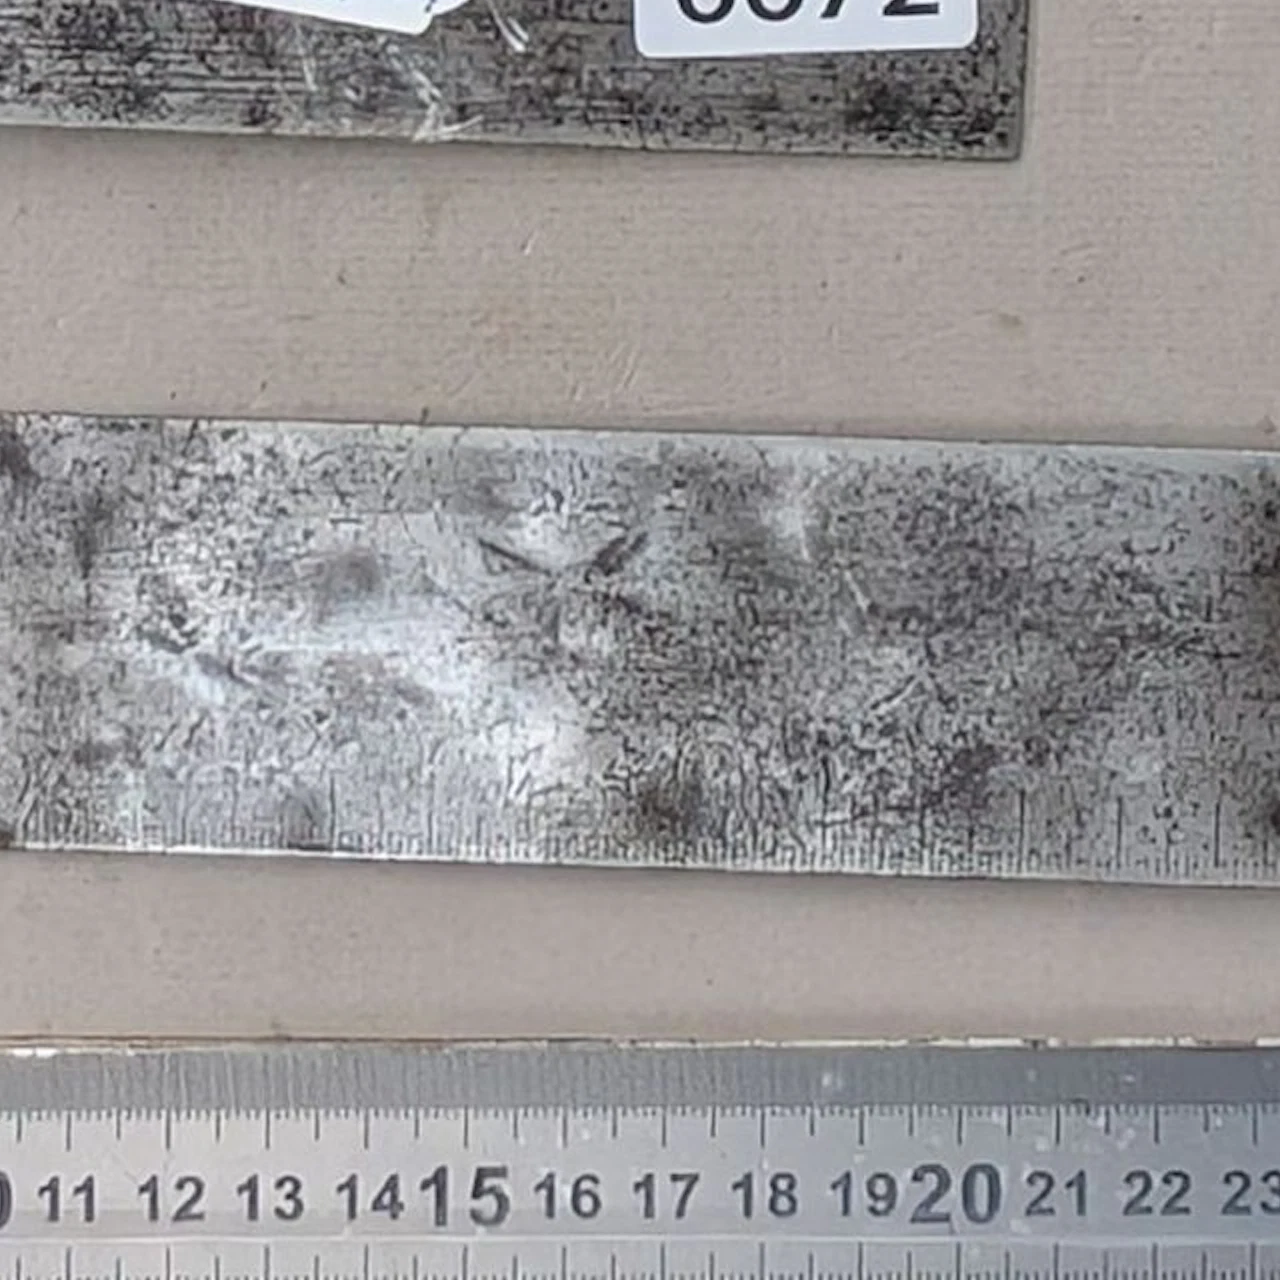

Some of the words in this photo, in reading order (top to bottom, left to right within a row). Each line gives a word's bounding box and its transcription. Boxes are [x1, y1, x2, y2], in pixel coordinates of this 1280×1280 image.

[36, 1174, 96, 1225] 11
[137, 1173, 207, 1226] 12
[235, 1173, 305, 1224] 13
[335, 1172, 406, 1225] 14
[418, 1164, 511, 1229] 15
[533, 1171, 603, 1221] 16
[632, 1172, 701, 1221] 17
[730, 1170, 798, 1221] 18
[829, 1169, 898, 1218] 19
[908, 1162, 1002, 1226] 20
[1024, 1168, 1087, 1218] 21
[1121, 1169, 1192, 1217] 22
